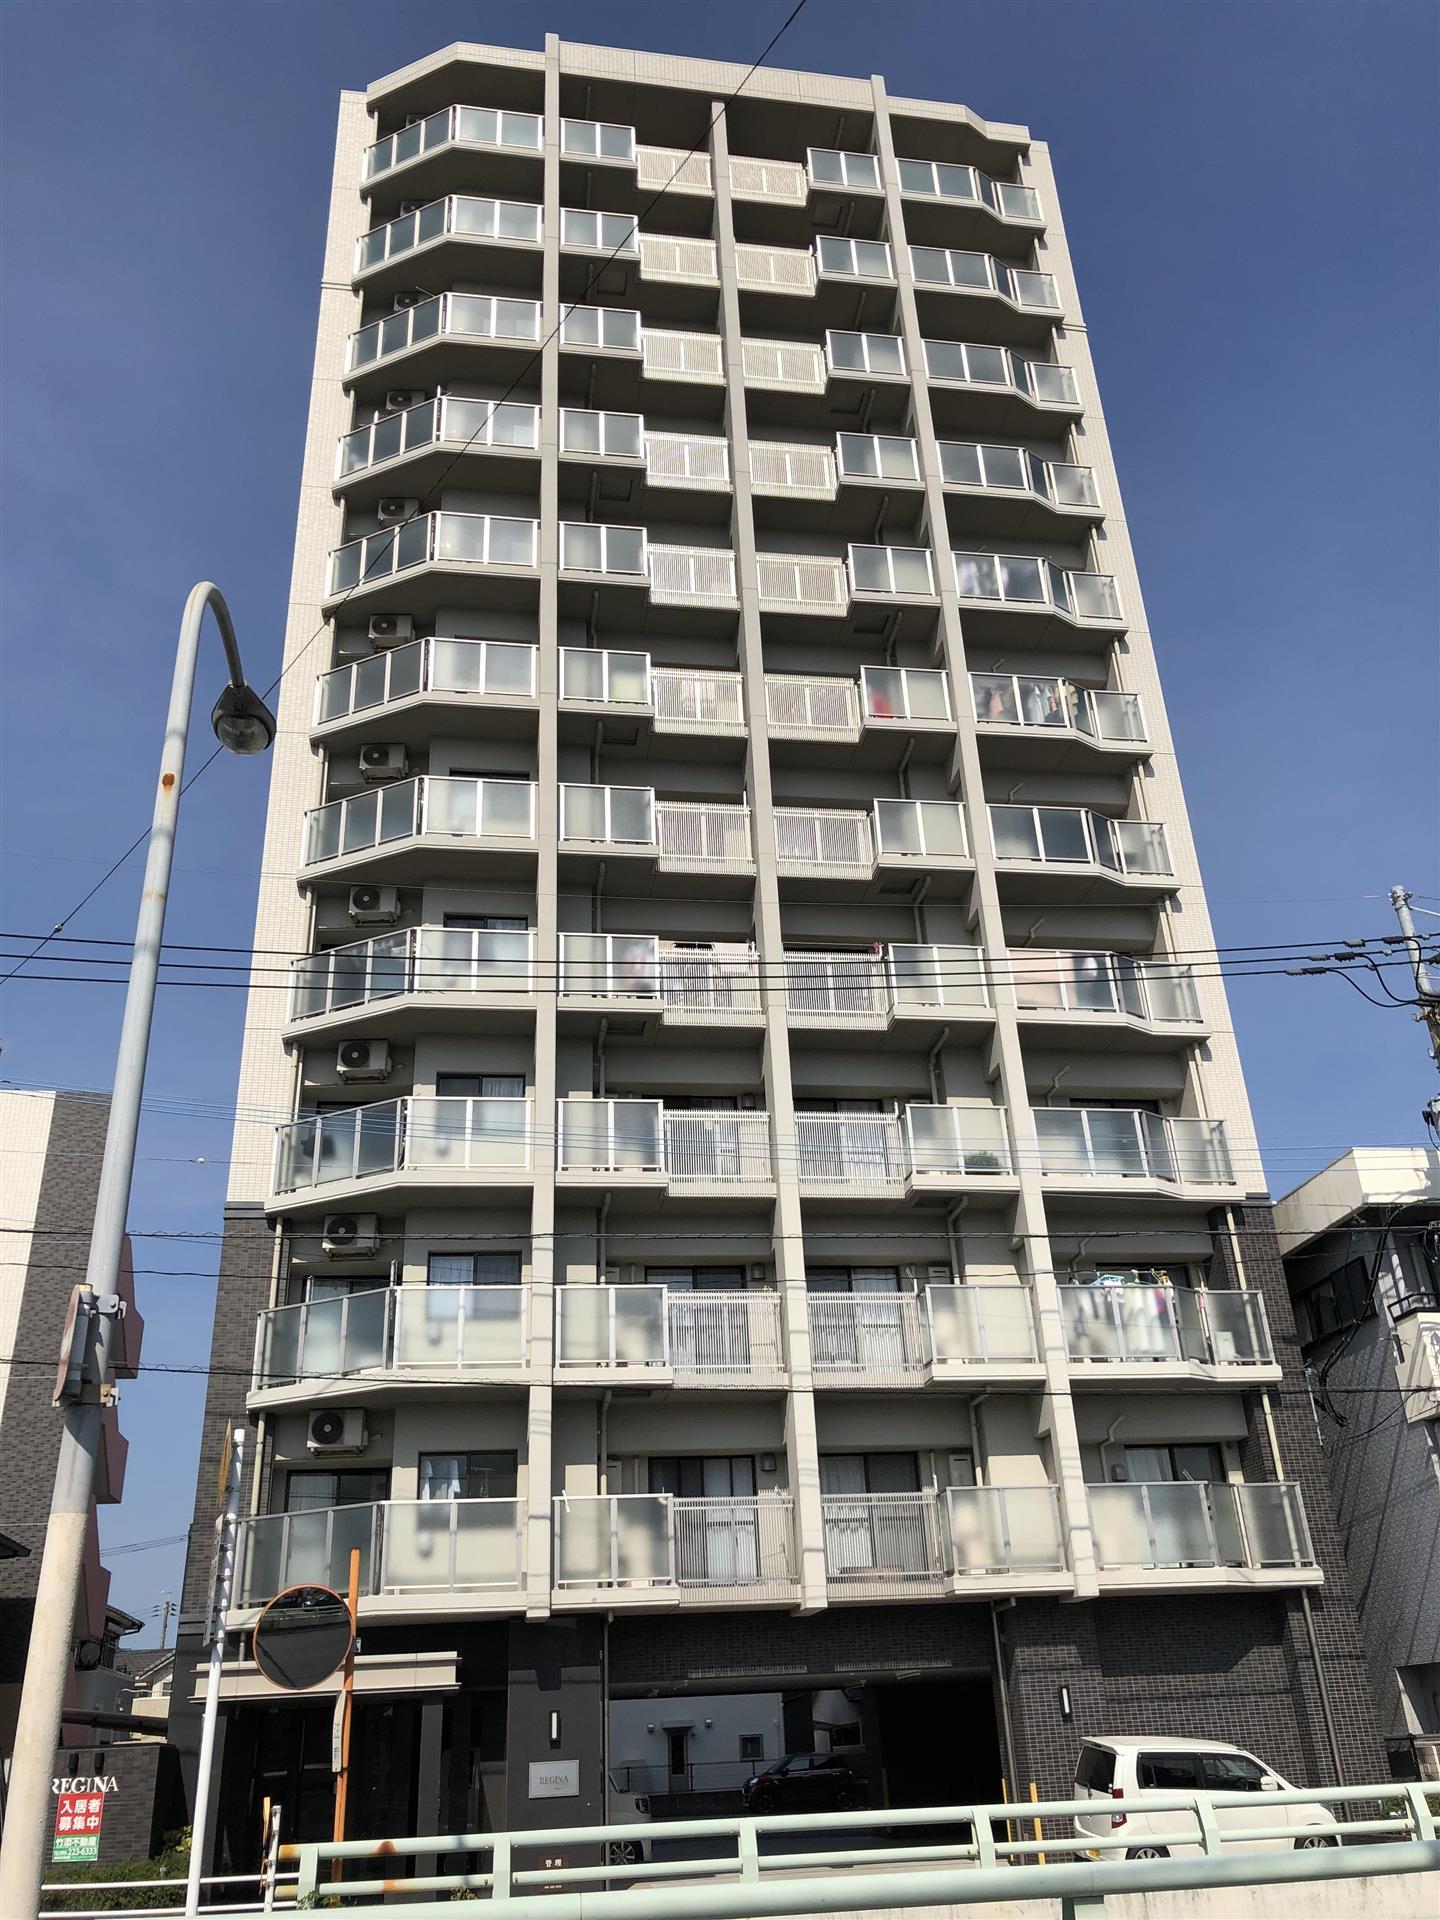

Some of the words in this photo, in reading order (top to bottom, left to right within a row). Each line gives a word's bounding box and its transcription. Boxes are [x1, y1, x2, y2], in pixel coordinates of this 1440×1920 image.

[539, 1775, 569, 1785] REGINA
[60, 1799, 101, 1814] 入居者
[58, 1815, 99, 1831] 募集中
